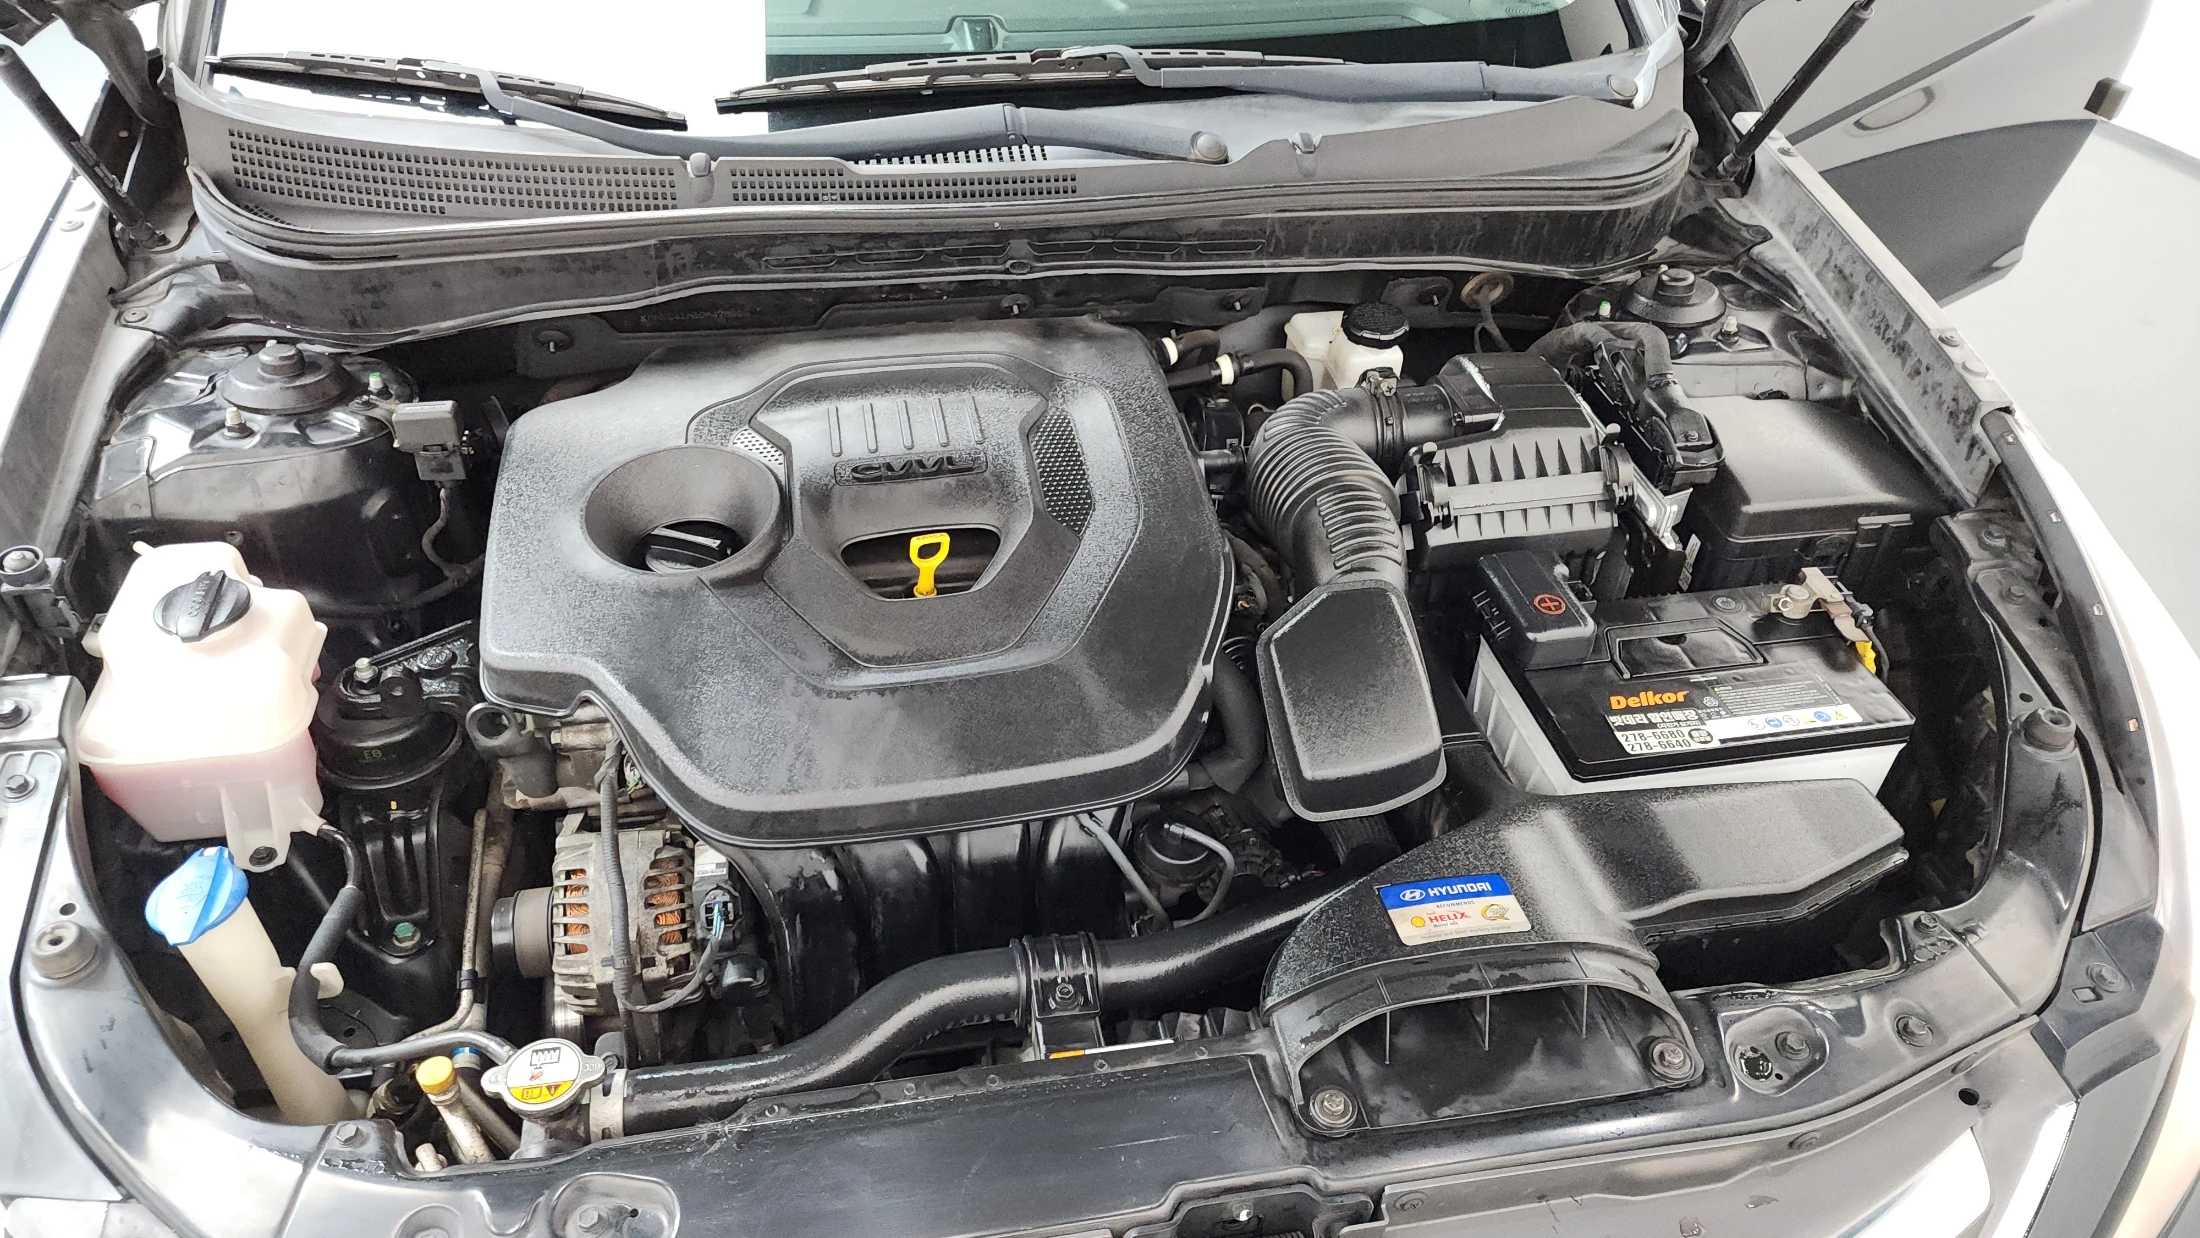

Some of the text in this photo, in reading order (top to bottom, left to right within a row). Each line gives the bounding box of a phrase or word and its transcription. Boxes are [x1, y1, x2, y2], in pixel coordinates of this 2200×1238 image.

[850, 455, 975, 483] CVVL
[1609, 690, 1688, 710] Delkor
[1609, 713, 1649, 726] 밧데리
[1621, 729, 1685, 743] 278-6680
[1627, 738, 1691, 752] 278-6640
[1428, 882, 1492, 897] HYUNDAI
[1429, 912, 1469, 924] HELIX
